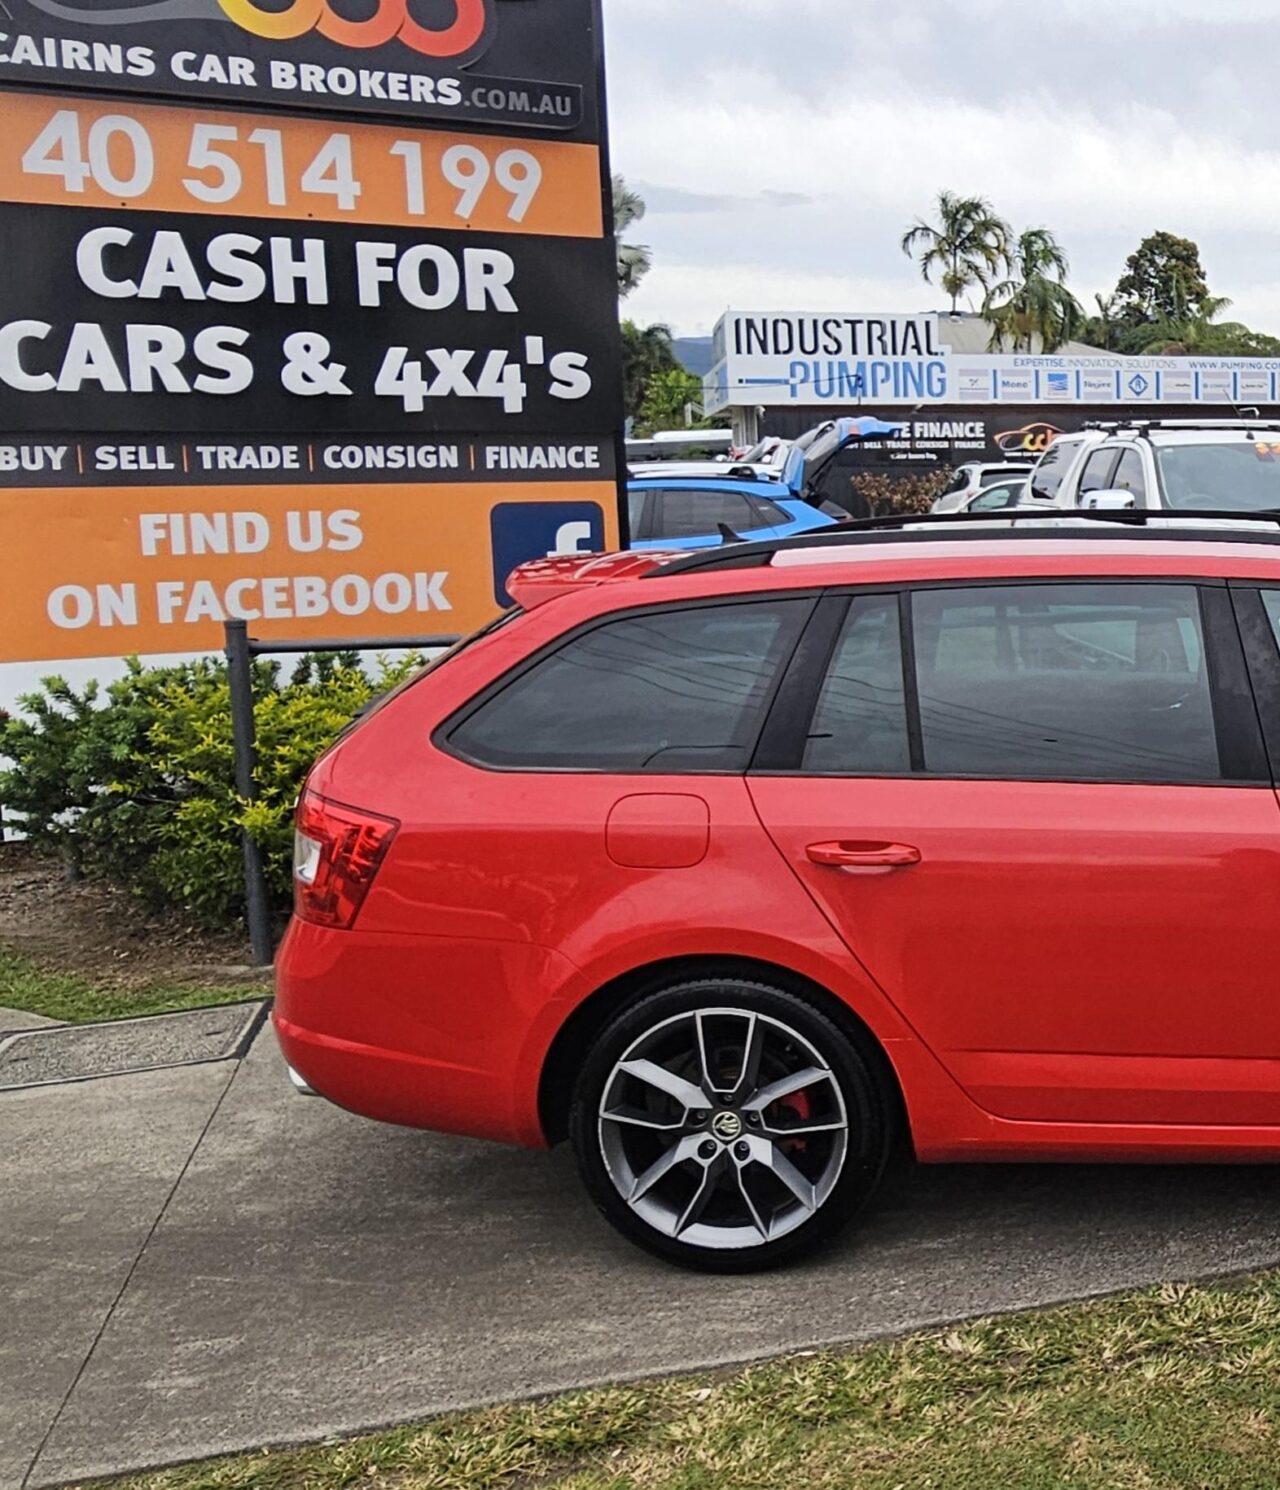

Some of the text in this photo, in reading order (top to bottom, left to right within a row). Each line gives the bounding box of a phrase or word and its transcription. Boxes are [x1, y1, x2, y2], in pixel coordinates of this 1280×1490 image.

[170, 51, 257, 86] CAR
[21, 110, 543, 223] 40 514 199
[76, 227, 519, 313] CASH FOR
[0, 319, 254, 394] CARS
[280, 332, 353, 396] &
[734, 318, 939, 356] INDUSTRIAL
[789, 361, 947, 398] PUMPING
[914, 421, 986, 438] FINANCE
[0, 445, 600, 471] BUY SELL TRADE CONSIGN FINANCE
[139, 510, 363, 556] FIND US
[47, 571, 453, 629] ON FACEBOOK
